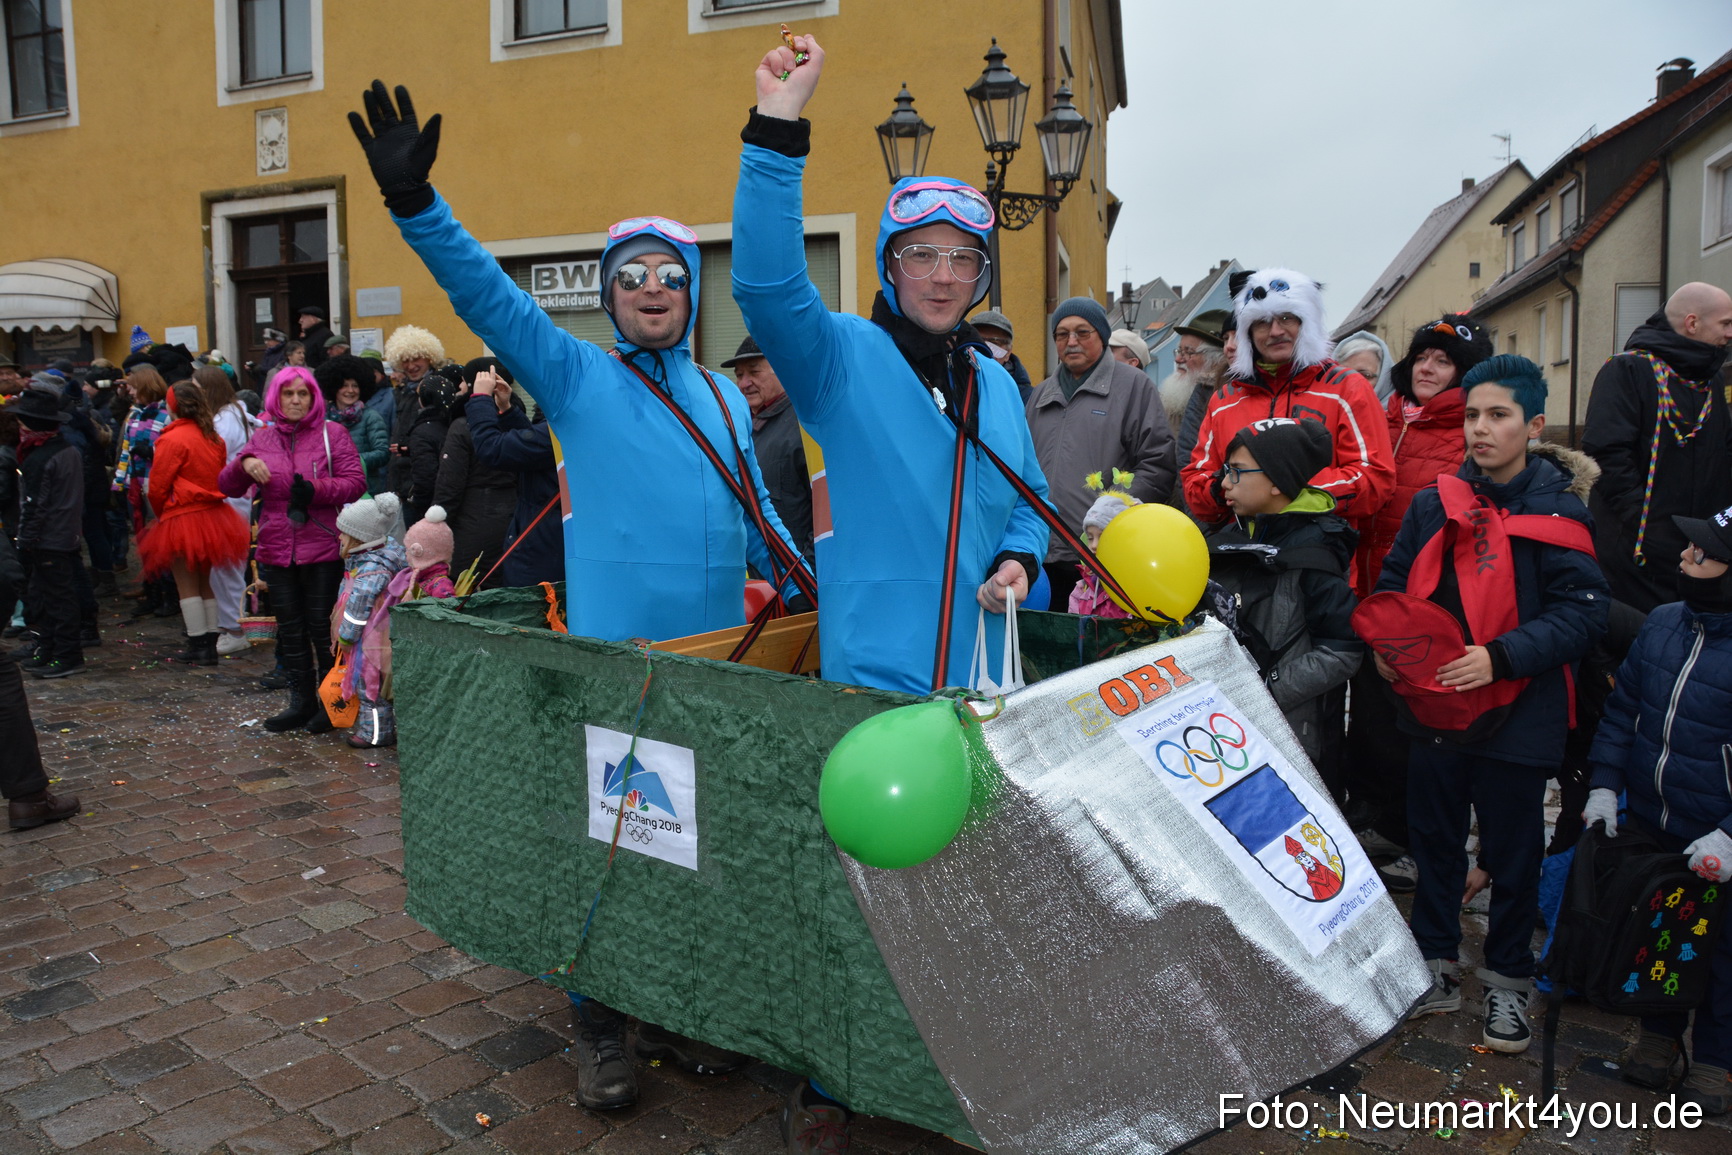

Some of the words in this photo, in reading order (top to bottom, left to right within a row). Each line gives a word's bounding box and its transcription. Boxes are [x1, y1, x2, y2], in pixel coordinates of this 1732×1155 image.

[535, 264, 597, 291] BW
[1137, 717, 1177, 739] Berching
[1173, 708, 1186, 723] bei
[1184, 696, 1216, 714] Olympia
[659, 819, 682, 834] 2018
[1318, 894, 1366, 937] PyeongChang
[1359, 877, 1379, 898] 2018
